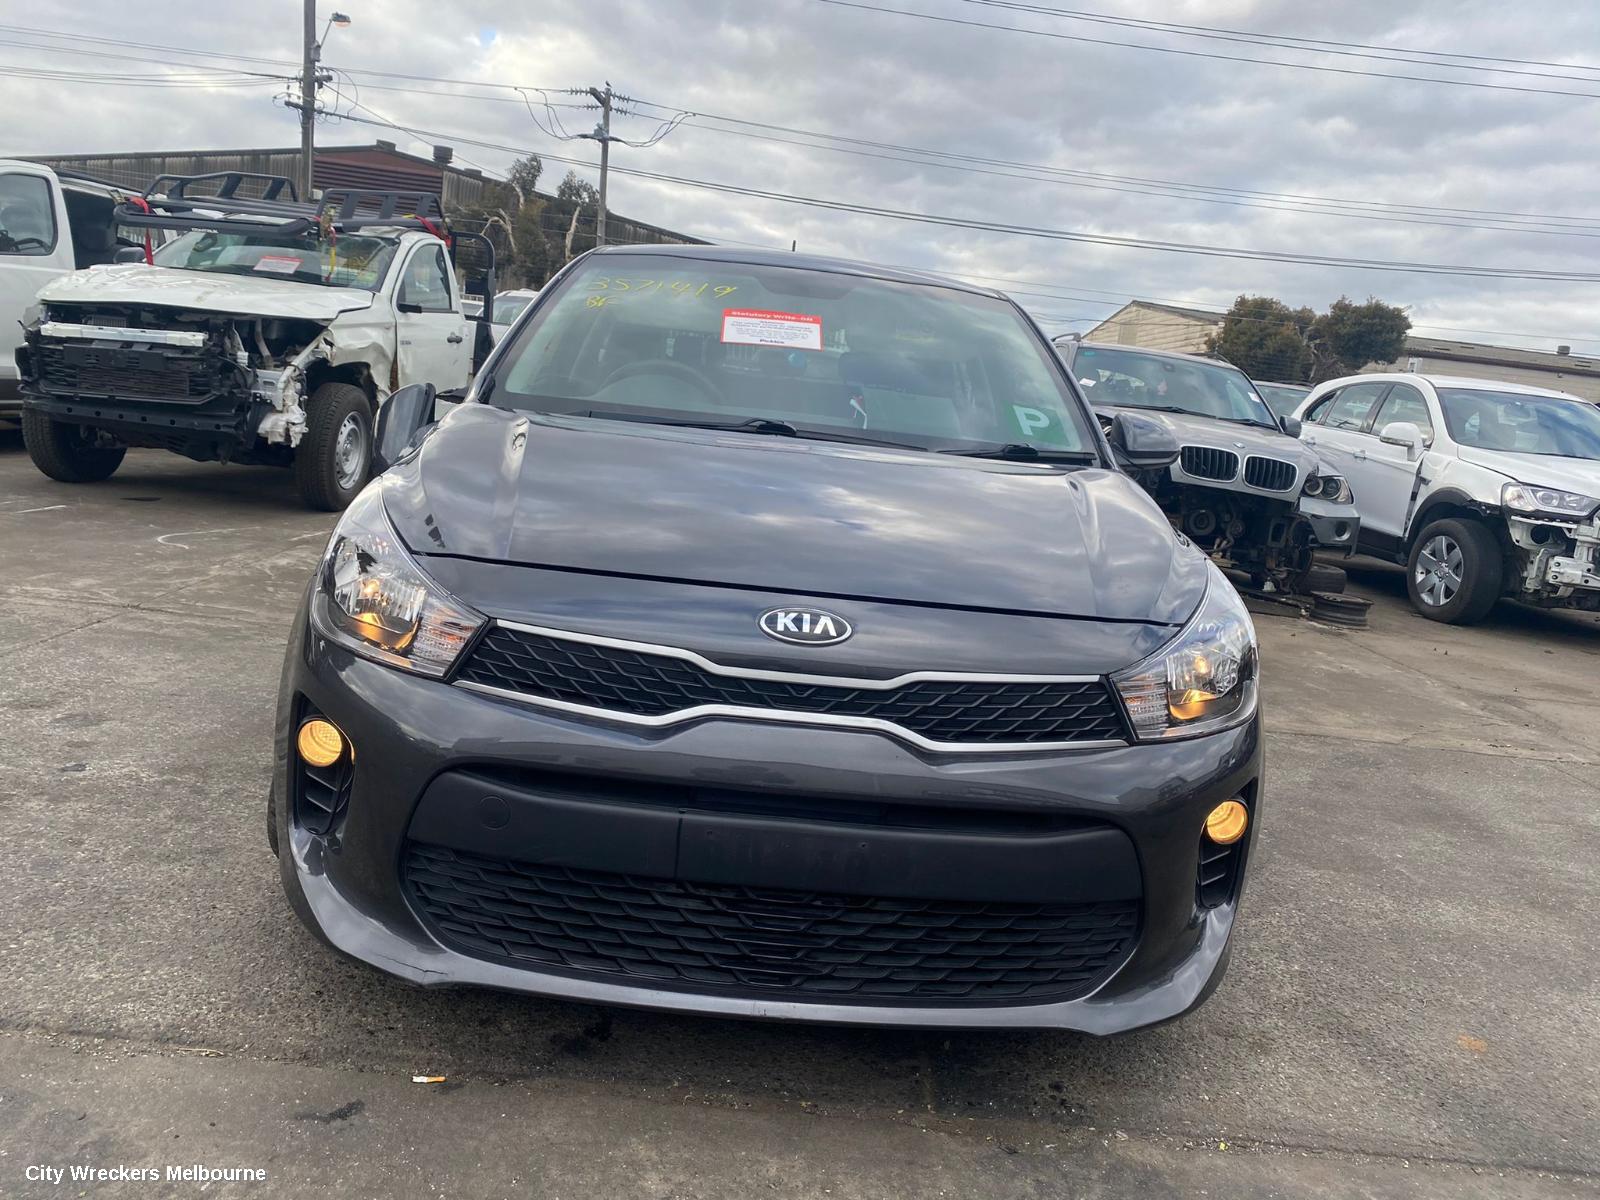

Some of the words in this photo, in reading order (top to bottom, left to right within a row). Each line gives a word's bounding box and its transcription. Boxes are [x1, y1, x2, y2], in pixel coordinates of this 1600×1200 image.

[731, 310, 771, 319] Statutory
[1012, 405, 1050, 436] P
[776, 611, 838, 637] KIA
